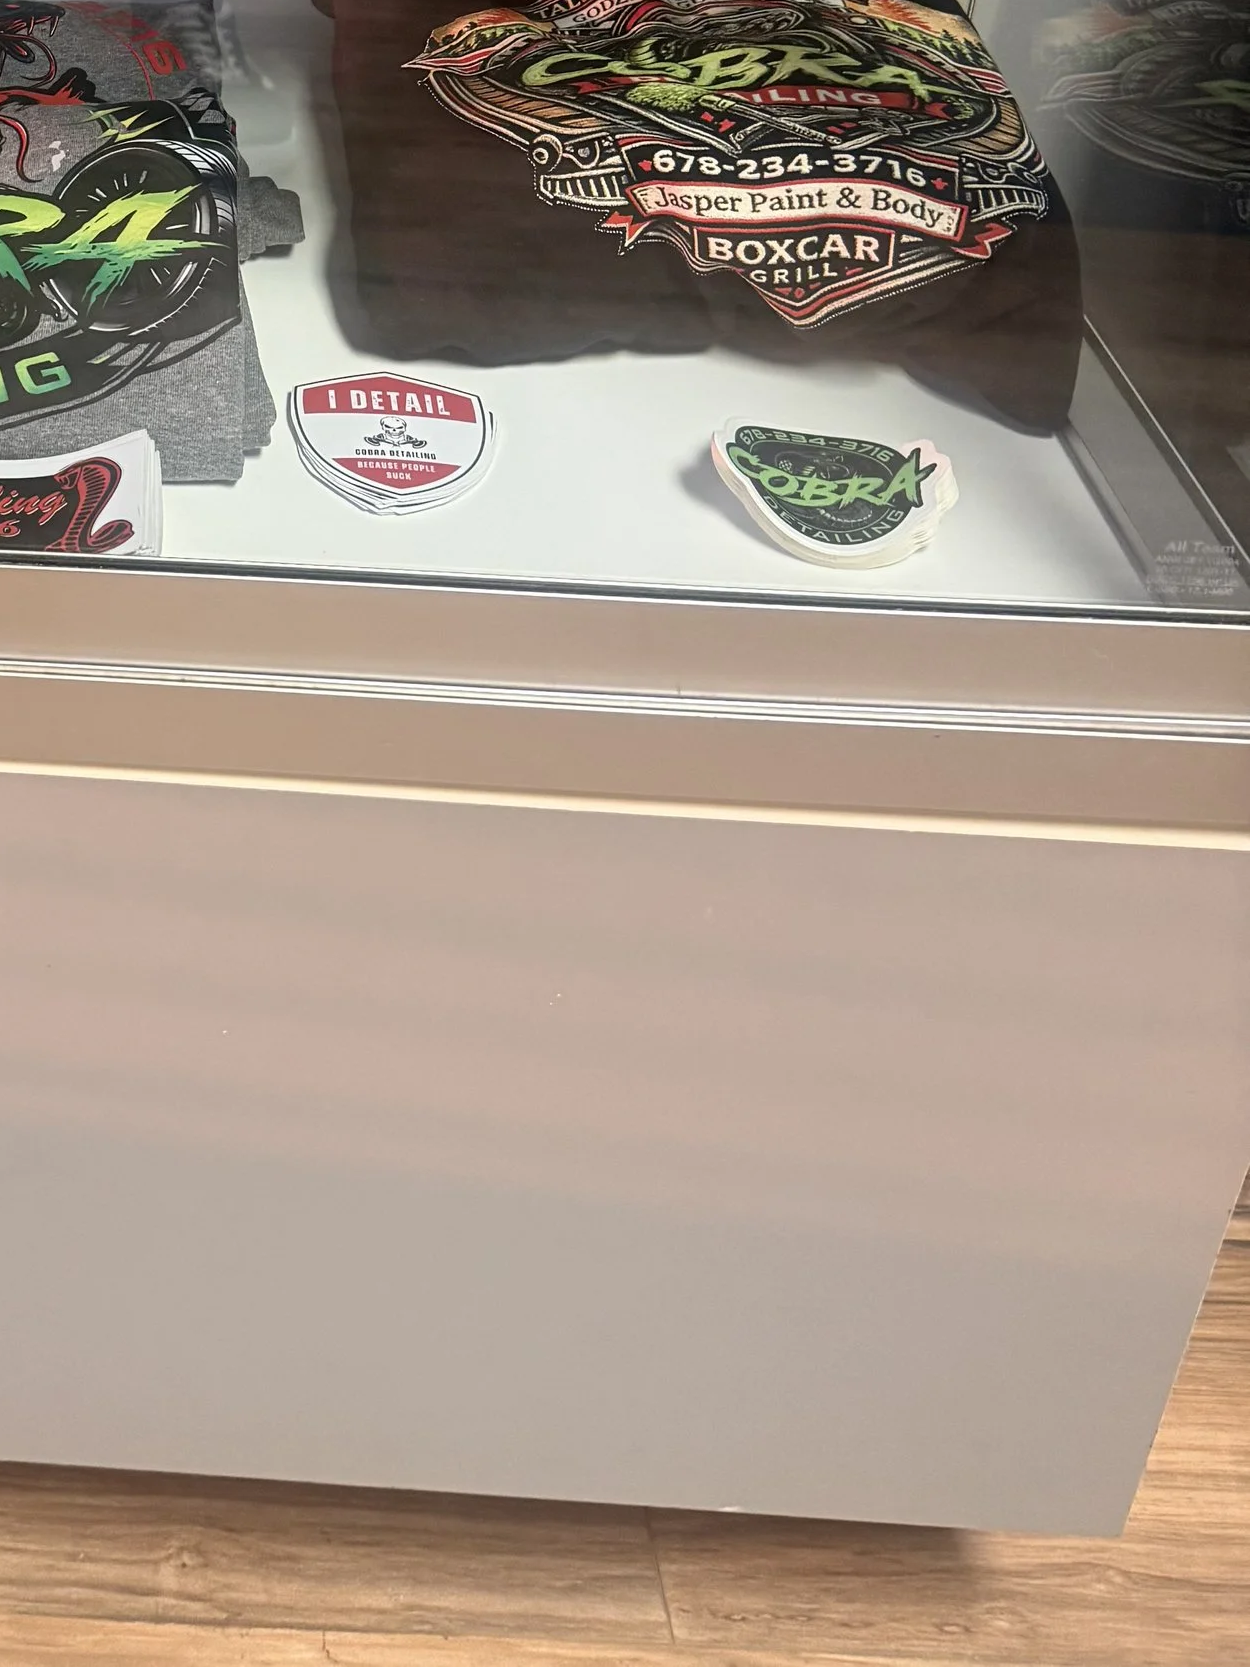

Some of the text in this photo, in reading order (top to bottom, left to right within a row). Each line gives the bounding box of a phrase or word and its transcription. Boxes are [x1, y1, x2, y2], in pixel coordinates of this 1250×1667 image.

[522, 45, 988, 104] COBRA
[652, 148, 927, 187] 678-234-3716
[654, 186, 741, 217] Jasper
[749, 188, 827, 213] Paint
[835, 186, 862, 209] &
[871, 188, 945, 229] Body
[706, 234, 881, 264] BOXCAR
[750, 262, 839, 284] GRILL
[328, 389, 451, 416] I DETAIL
[355, 448, 437, 461] COBRA DETAILING
[739, 429, 895, 462] 678-234-3716
[357, 460, 436, 473] BECAUSE PEOPLE
[386, 470, 412, 481] SUCK
[727, 447, 932, 509] COBRA
[762, 495, 905, 543] DETAILING
